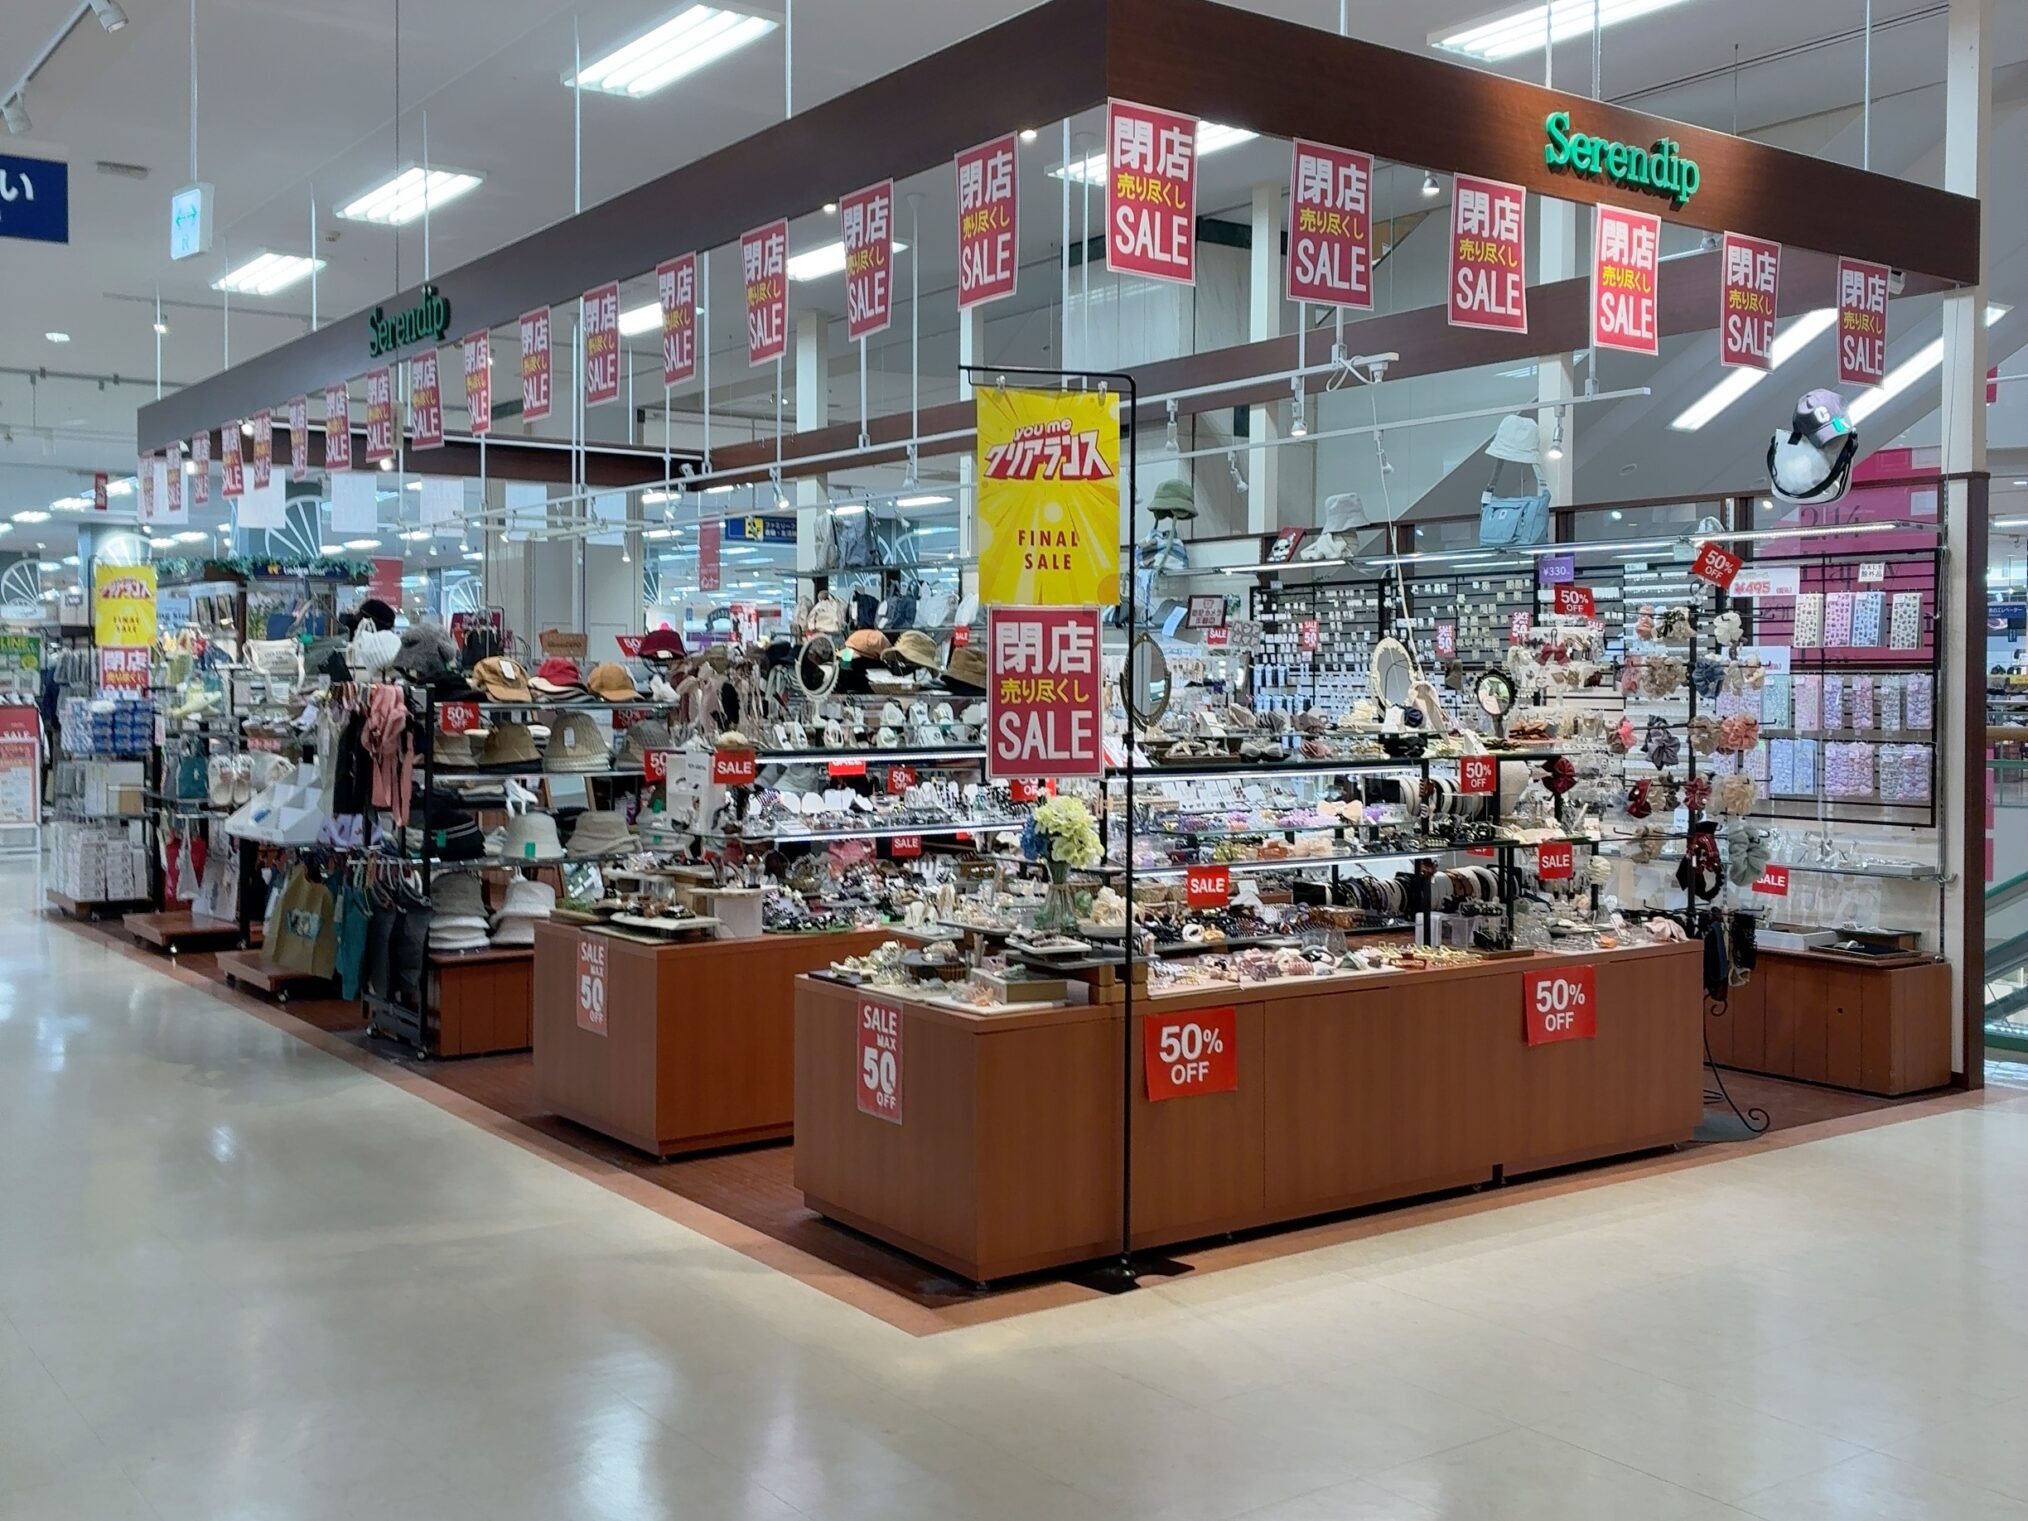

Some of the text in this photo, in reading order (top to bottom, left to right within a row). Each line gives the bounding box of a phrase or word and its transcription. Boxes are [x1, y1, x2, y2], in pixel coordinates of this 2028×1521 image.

[1113, 115, 1193, 182] 閉店
[1545, 111, 1699, 203] Serendip
[959, 150, 1013, 214] 閉店
[1117, 172, 1186, 209] 売り尽くし
[1297, 153, 1368, 216] 閉店
[844, 195, 889, 250] 閉店
[962, 207, 1010, 241] 売り尽くし
[1299, 207, 1364, 241] 売り尽くし
[1457, 188, 1521, 244] 閉店
[1115, 204, 1188, 267] SALE
[1600, 218, 1655, 270] 閉店
[744, 233, 785, 286] 閉店
[962, 232, 1011, 292] SALE
[1296, 238, 1367, 293] SALE
[1459, 238, 1518, 268] 売り尽くし
[1726, 245, 1777, 294] 閉店
[659, 264, 693, 310] 閉店
[1456, 266, 1522, 317] SALE
[1602, 264, 1652, 294] 売り尽くし
[1841, 268, 1887, 314] 閉店
[585, 293, 617, 336] 閉店
[849, 270, 886, 325] SALE
[1728, 289, 1773, 315] 売り尽くし
[369, 286, 449, 355] Serendip
[749, 303, 783, 350] SALE
[1600, 291, 1653, 339] SALE
[1843, 311, 1883, 335] 売り尽くし
[664, 329, 692, 373] SALE
[1727, 316, 1774, 359] SALE
[1843, 335, 1884, 376] SALE
[587, 354, 616, 393] SALE
[523, 372, 549, 411] SALE
[413, 407, 440, 438] SALE
[1015, 419, 1072, 440] you me
[985, 431, 1112, 478] クリアランス
[1019, 530, 1079, 547] FINAL
[1024, 554, 1072, 570] SALE
[1543, 566, 1566, 576] ¥330
[1705, 549, 1733, 574] 50%
[1705, 567, 1723, 579] OFF
[1561, 590, 1589, 604] 50%
[1566, 604, 1584, 612] OFF
[995, 621, 1094, 675] 閉店
[1210, 629, 1227, 638] SALE
[1304, 632, 1317, 643] 50
[1001, 679, 1089, 704] 売り尽くし
[447, 707, 474, 720] 50%
[998, 710, 1094, 760] SALE
[650, 752, 667, 766] 50
[717, 761, 752, 774] SALE
[1466, 762, 1491, 778] 50%
[892, 771, 912, 782] 50%
[1470, 779, 1487, 788] OFF
[895, 839, 918, 848] SALE
[1542, 855, 1570, 868] SALE
[1190, 878, 1225, 894] SALE
[581, 941, 604, 966] SALE
[1536, 979, 1585, 1013] 50%
[863, 1005, 897, 1036] SALE
[1545, 1012, 1574, 1031] OFF
[876, 1033, 897, 1051] MAX
[1159, 1023, 1223, 1063] 50%
[863, 1046, 896, 1095] 50
[1171, 1061, 1209, 1084] OFF
[876, 1091, 896, 1110] OFF
